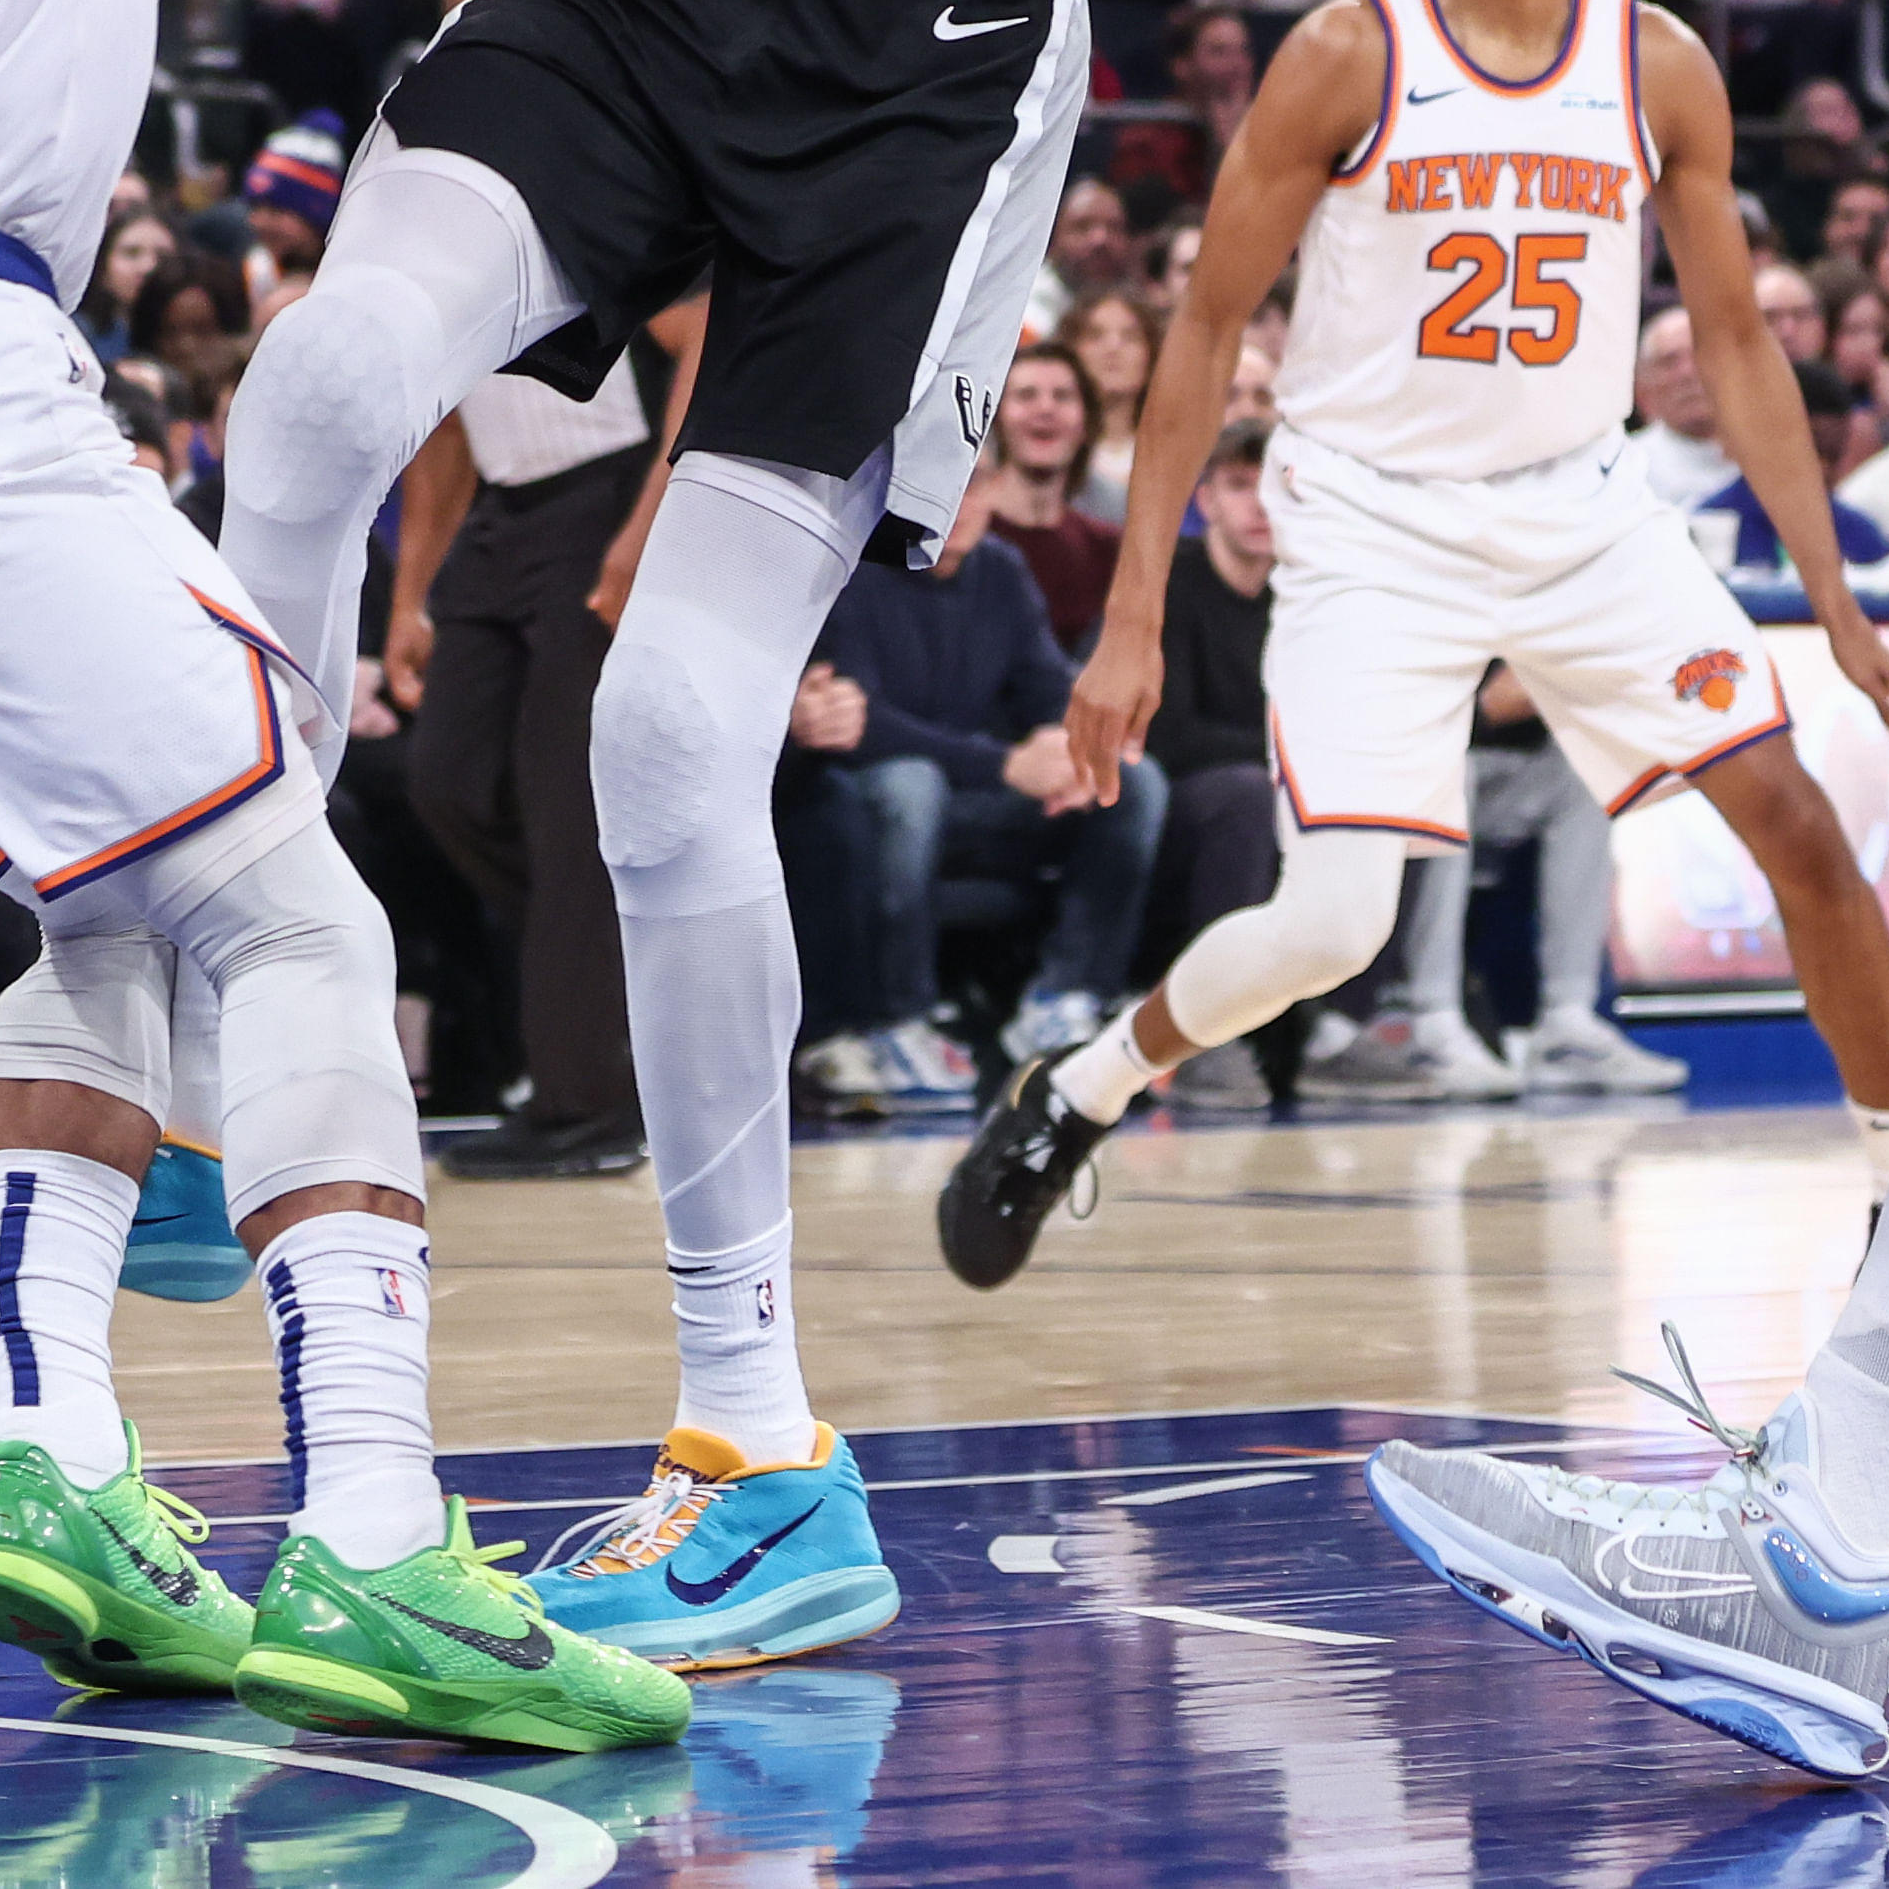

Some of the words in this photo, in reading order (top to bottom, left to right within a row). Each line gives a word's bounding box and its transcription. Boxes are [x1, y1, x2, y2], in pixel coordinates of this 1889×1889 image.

[1385, 153, 1507, 214] NEW
[1508, 153, 1632, 223] YORK
[1417, 231, 1590, 367] 25
